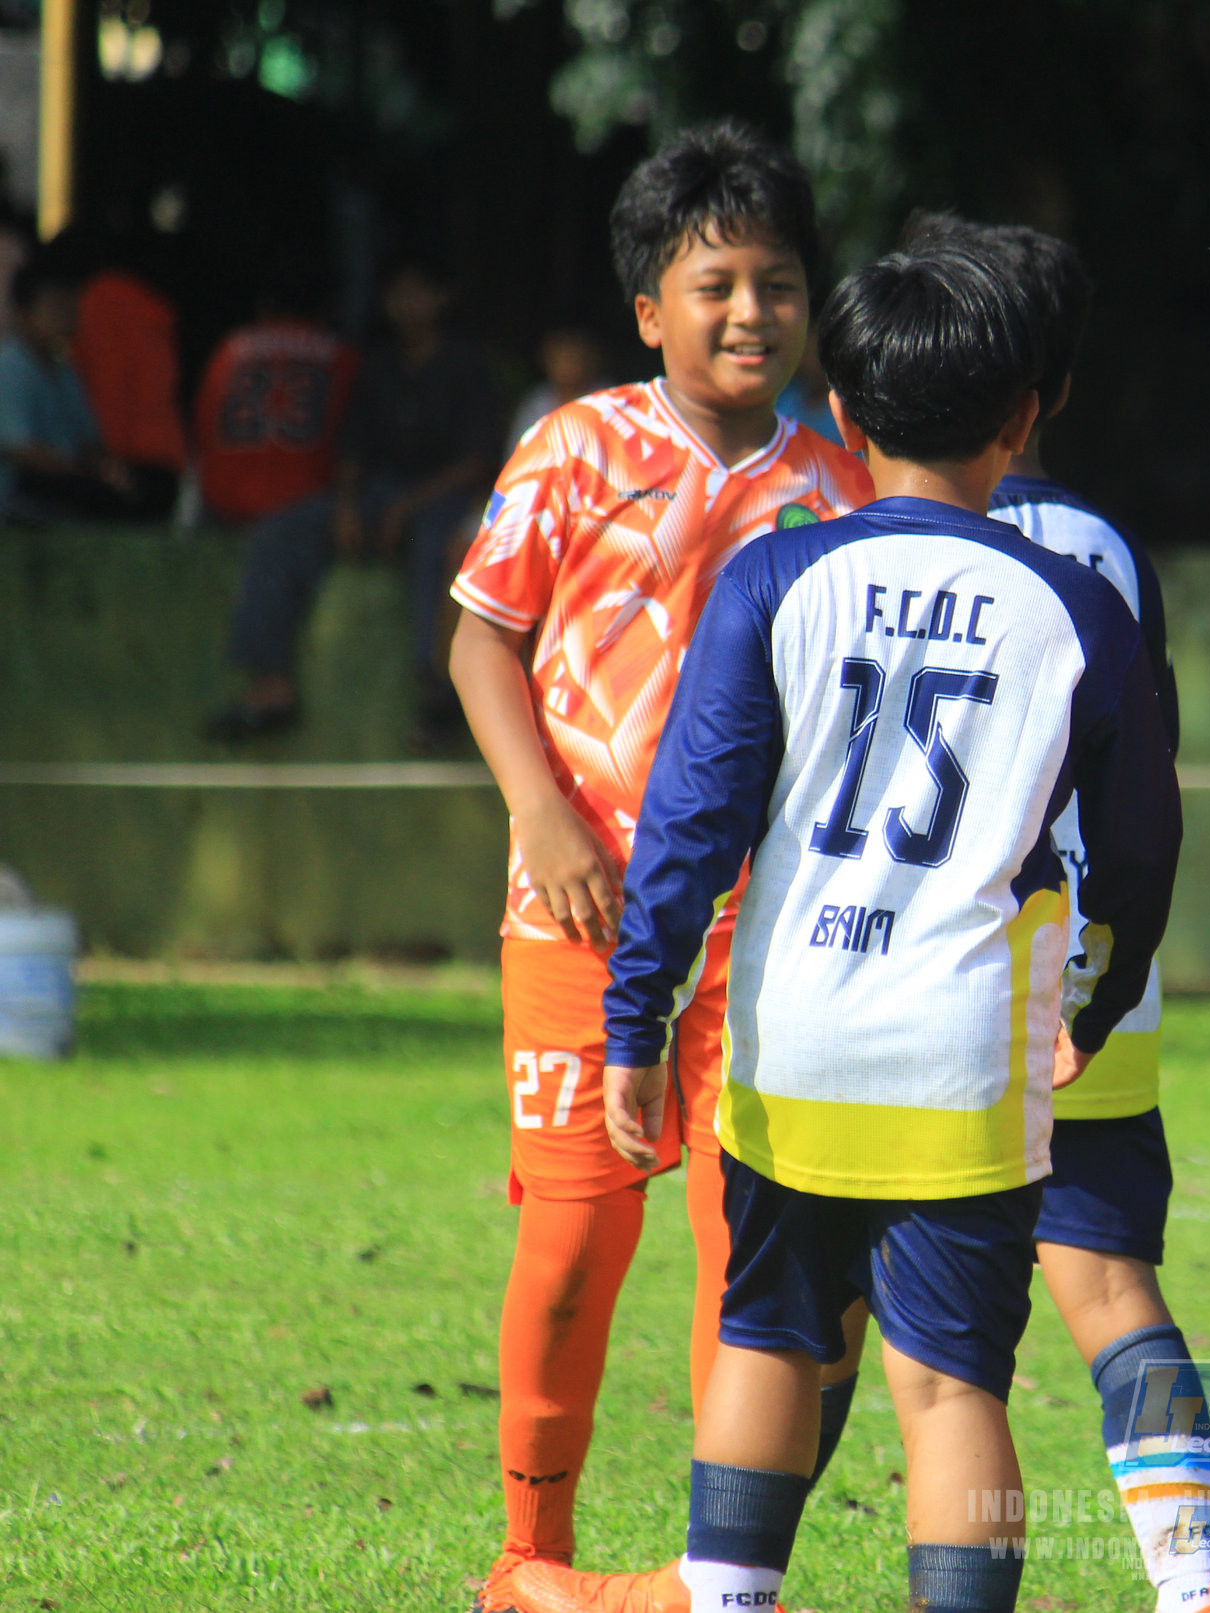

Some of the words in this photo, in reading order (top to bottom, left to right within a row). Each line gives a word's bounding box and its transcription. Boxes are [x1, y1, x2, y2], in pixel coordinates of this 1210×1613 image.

[865, 583, 995, 646] F.C.D.C
[808, 656, 1000, 869] 15
[809, 904, 896, 955] BAIM
[513, 1050, 582, 1129] 27
[721, 1591, 778, 1607] FCDC
